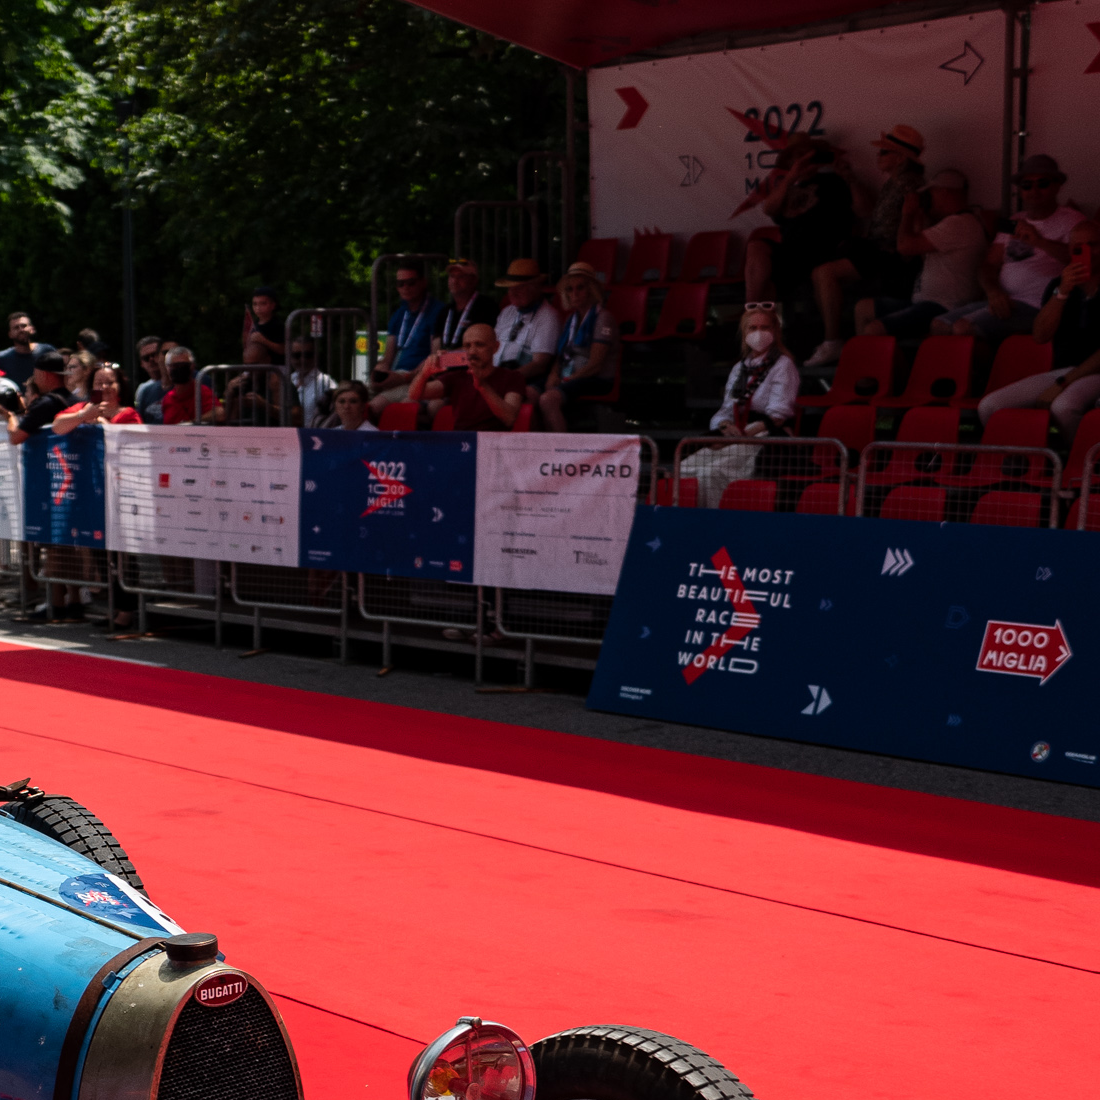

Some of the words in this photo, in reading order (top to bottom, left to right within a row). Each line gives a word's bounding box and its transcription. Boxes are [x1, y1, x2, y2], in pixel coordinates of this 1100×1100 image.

[744, 101, 825, 142] 2022
[368, 461, 407, 481] 2022
[539, 463, 632, 478] CHOPARD
[368, 484, 405, 495] 1000
[367, 497, 405, 508] MIGLIA
[689, 563, 738, 580] THE
[742, 567, 796, 585] MOST
[677, 584, 792, 609] BEAUTIFUL
[695, 608, 763, 629] RACE
[685, 630, 705, 645] IN
[711, 632, 762, 652] THE
[993, 628, 1050, 649] 1000
[677, 651, 760, 674] WORLD
[982, 650, 1048, 672] MIGLIA
[200, 982, 243, 1001] BUGATTI
